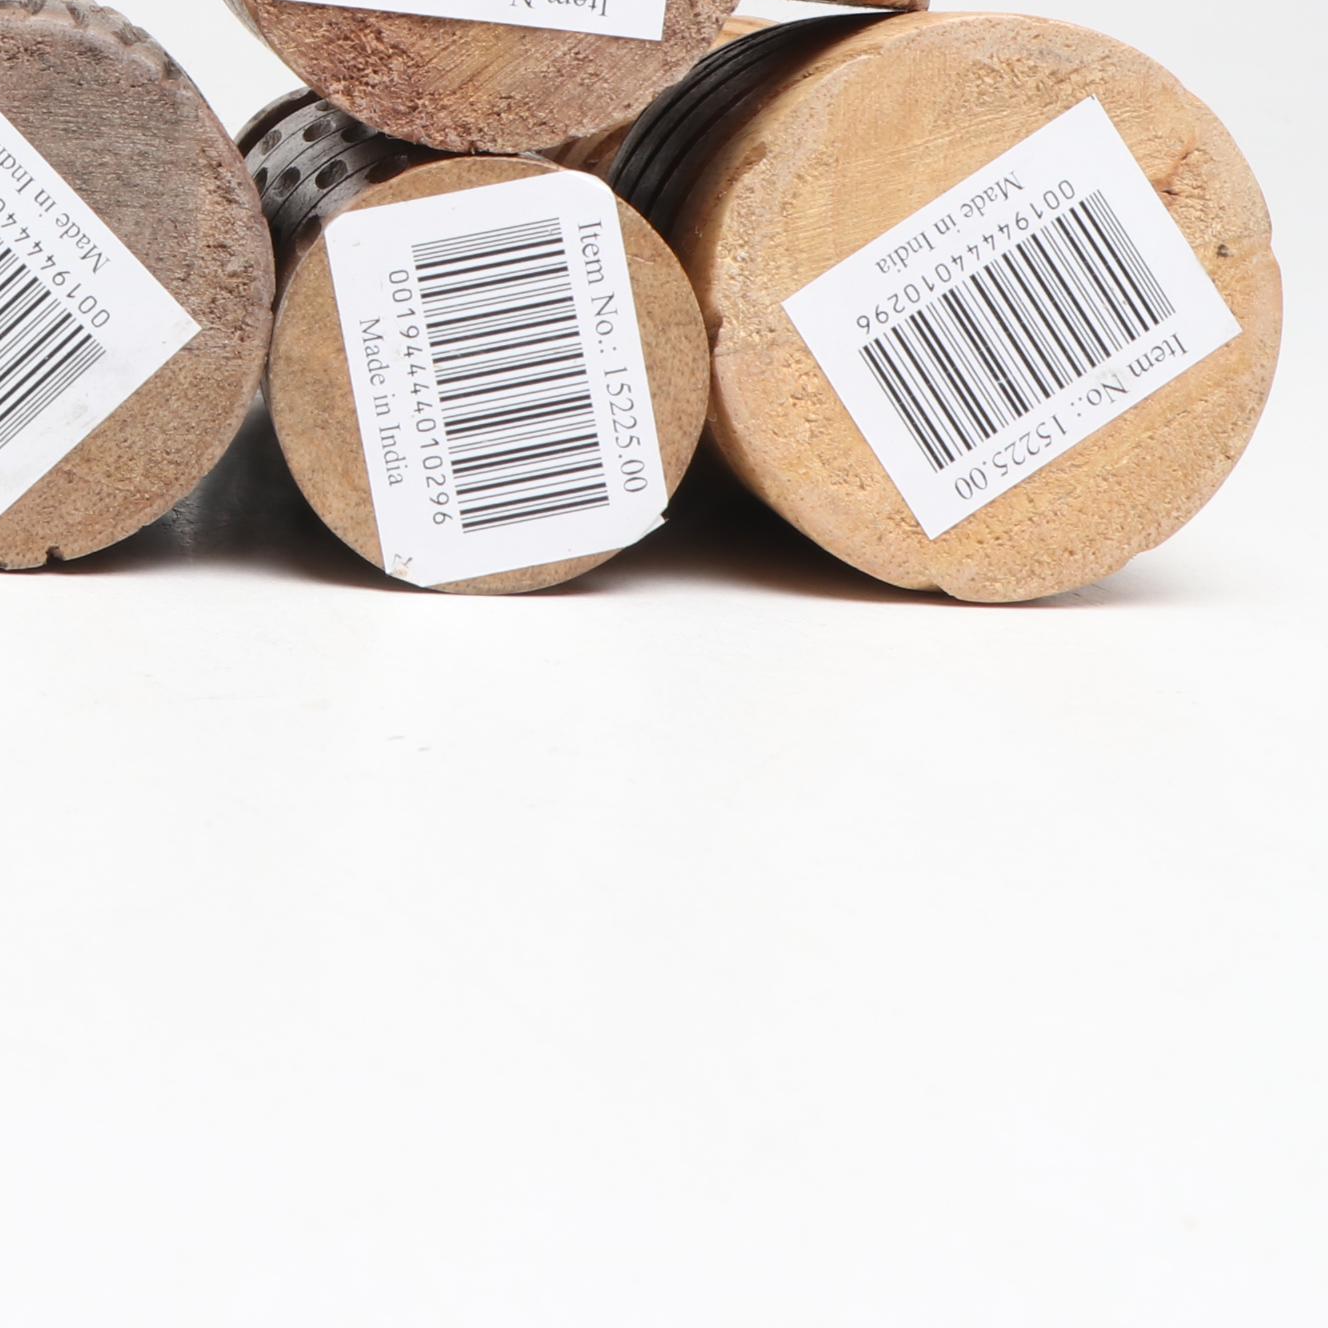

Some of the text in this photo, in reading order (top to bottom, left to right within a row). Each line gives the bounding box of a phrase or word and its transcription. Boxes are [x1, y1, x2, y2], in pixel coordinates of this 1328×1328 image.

[34, 188, 57, 218] in
[55, 212, 111, 275] Made
[856, 179, 1076, 335] 00194444010296
[875, 171, 1024, 274] Made in India
[359, 317, 409, 487] Made in India
[388, 269, 453, 525] 00194444010296
[577, 220, 648, 494] Item No.: 15225.00
[954, 333, 1188, 500] Item No.: 15225.00
